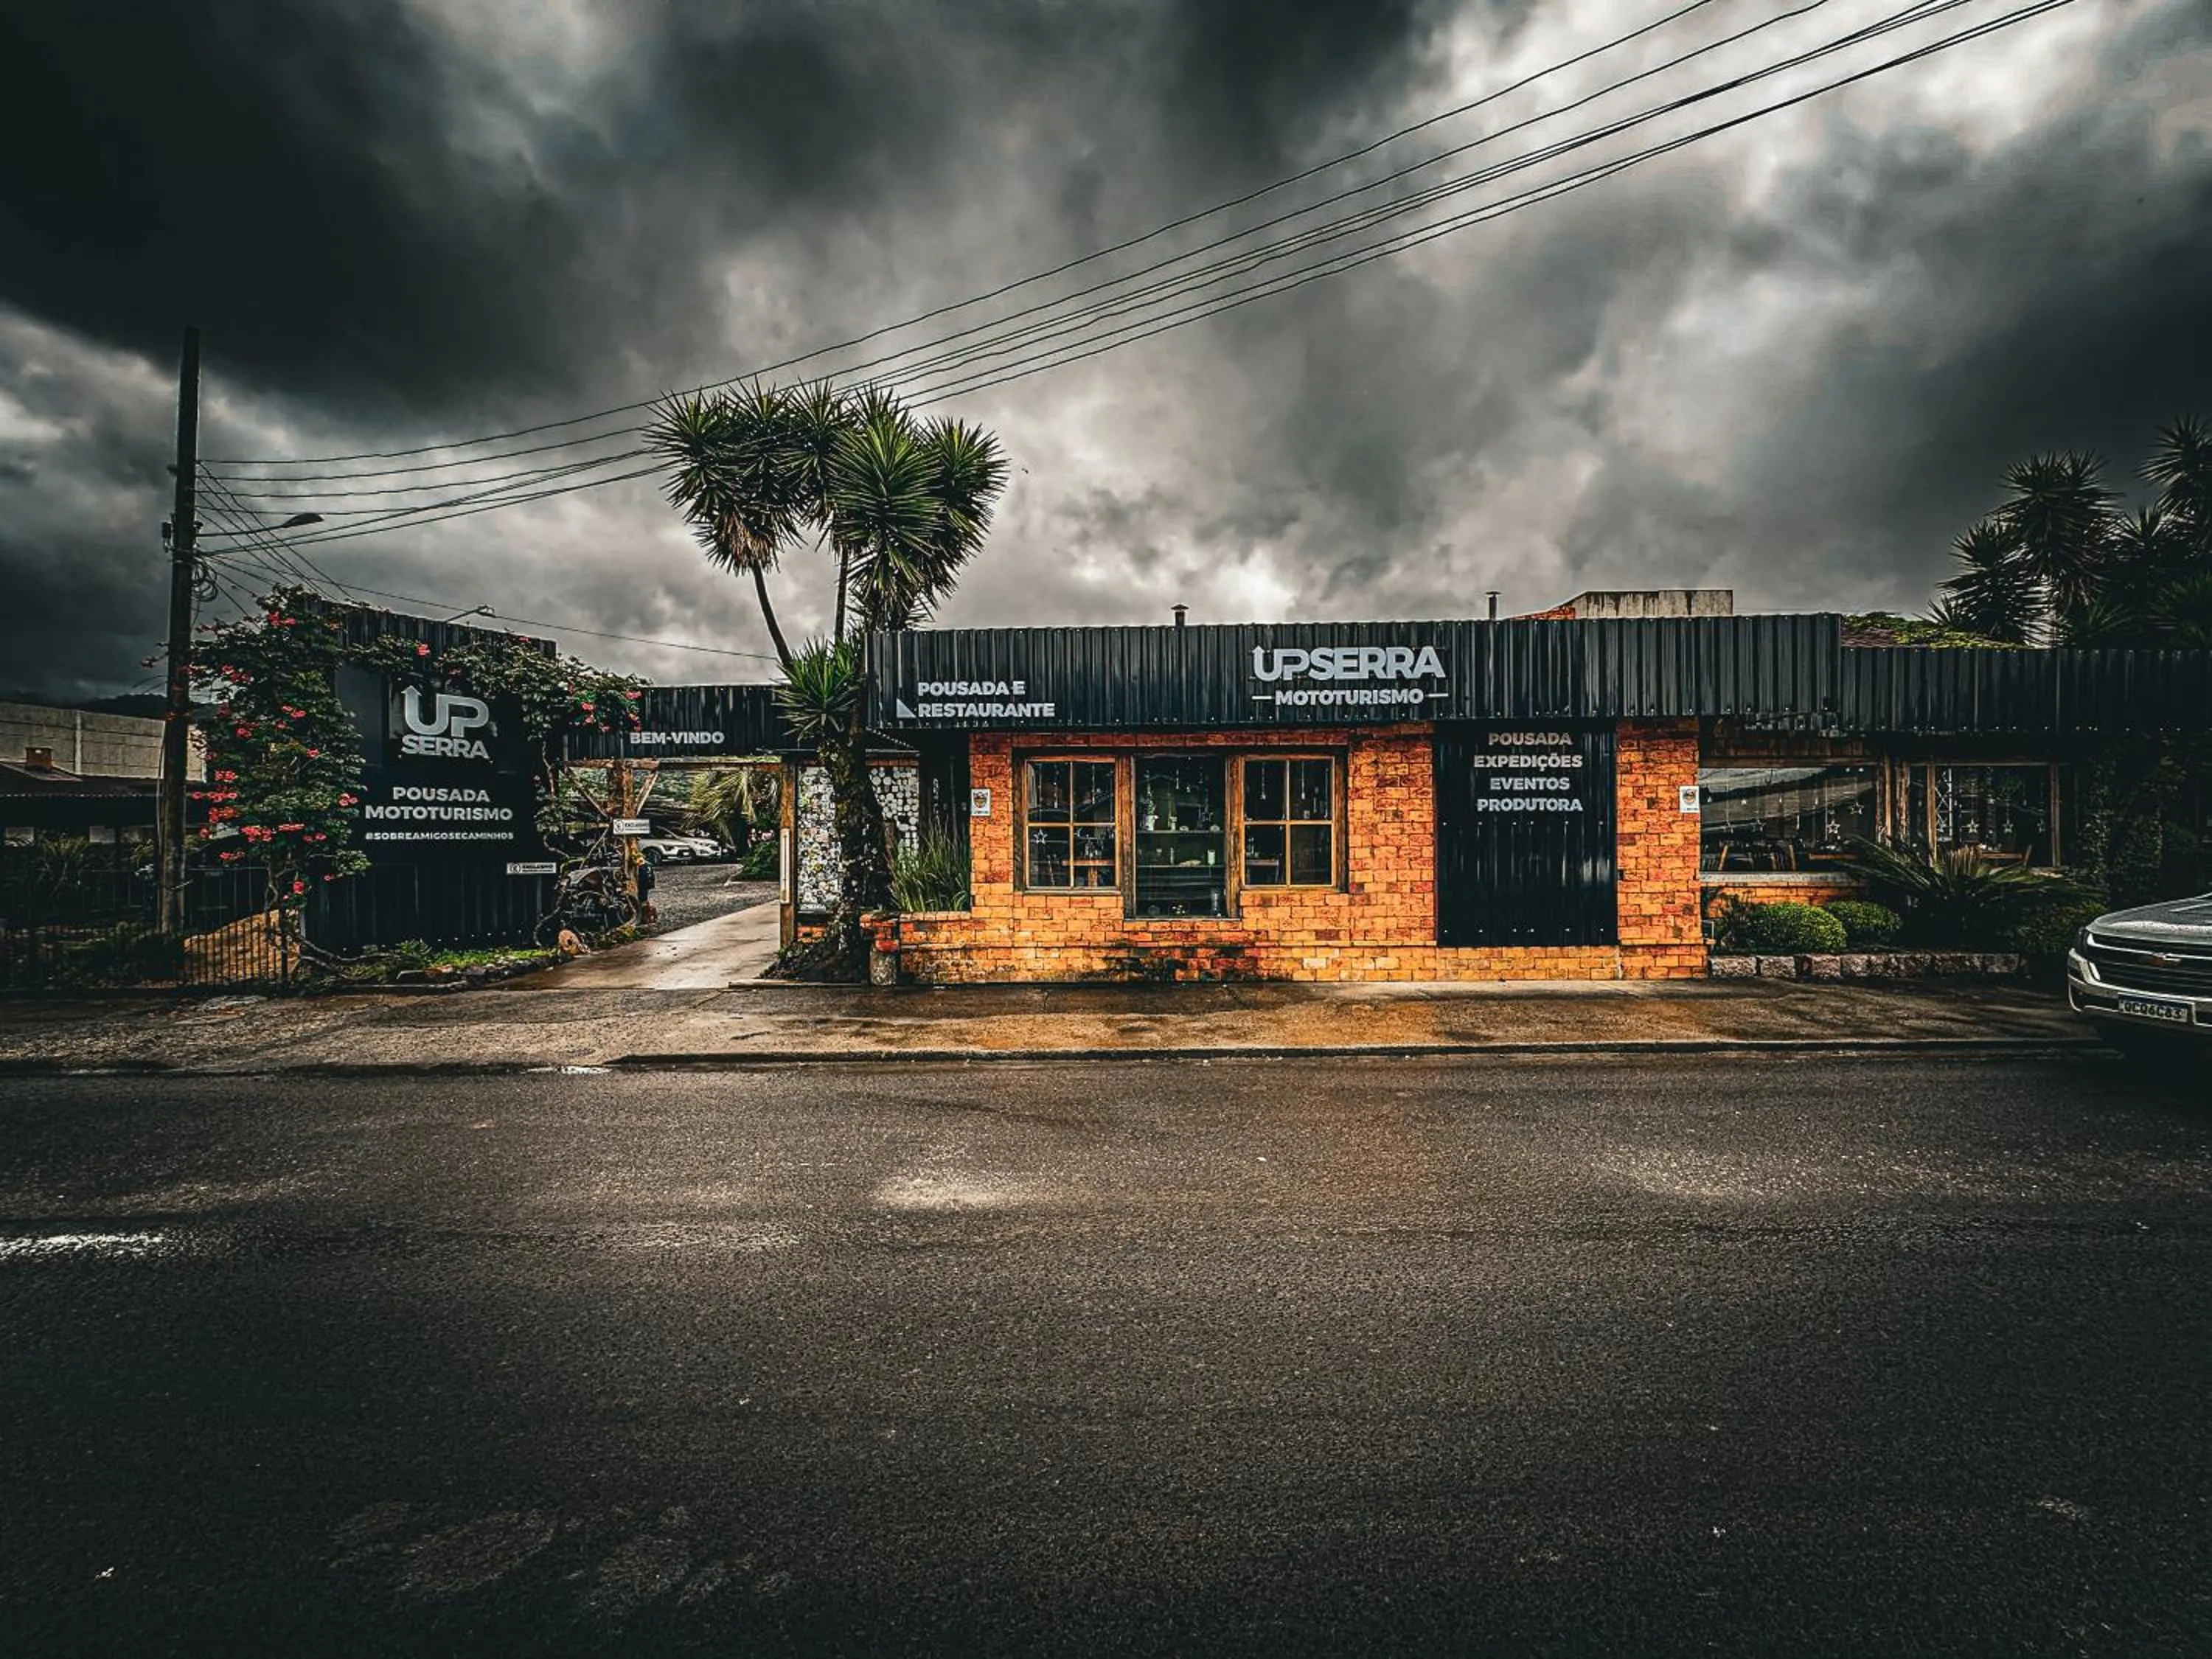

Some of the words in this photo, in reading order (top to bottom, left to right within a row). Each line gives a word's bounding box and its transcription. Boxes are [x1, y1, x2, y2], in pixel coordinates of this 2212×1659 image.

[917, 681, 1009, 696] POUSADA
[1012, 681, 1026, 695] E
[1275, 688, 1424, 705] MOTOTURISMO
[401, 686, 490, 737] UP
[918, 703, 1055, 717] RESTAURANTE
[630, 731, 725, 745] BEM-VINDO
[1488, 732, 1572, 745] POUSADA
[401, 734, 490, 759] SERRA
[1474, 753, 1583, 771] EXPEDIÇÕES
[1490, 777, 1570, 790] EVENTOS
[392, 787, 490, 802] POUSADA
[1477, 798, 1583, 812] PRODUTORA
[365, 805, 513, 821] MOTOTURISMO
